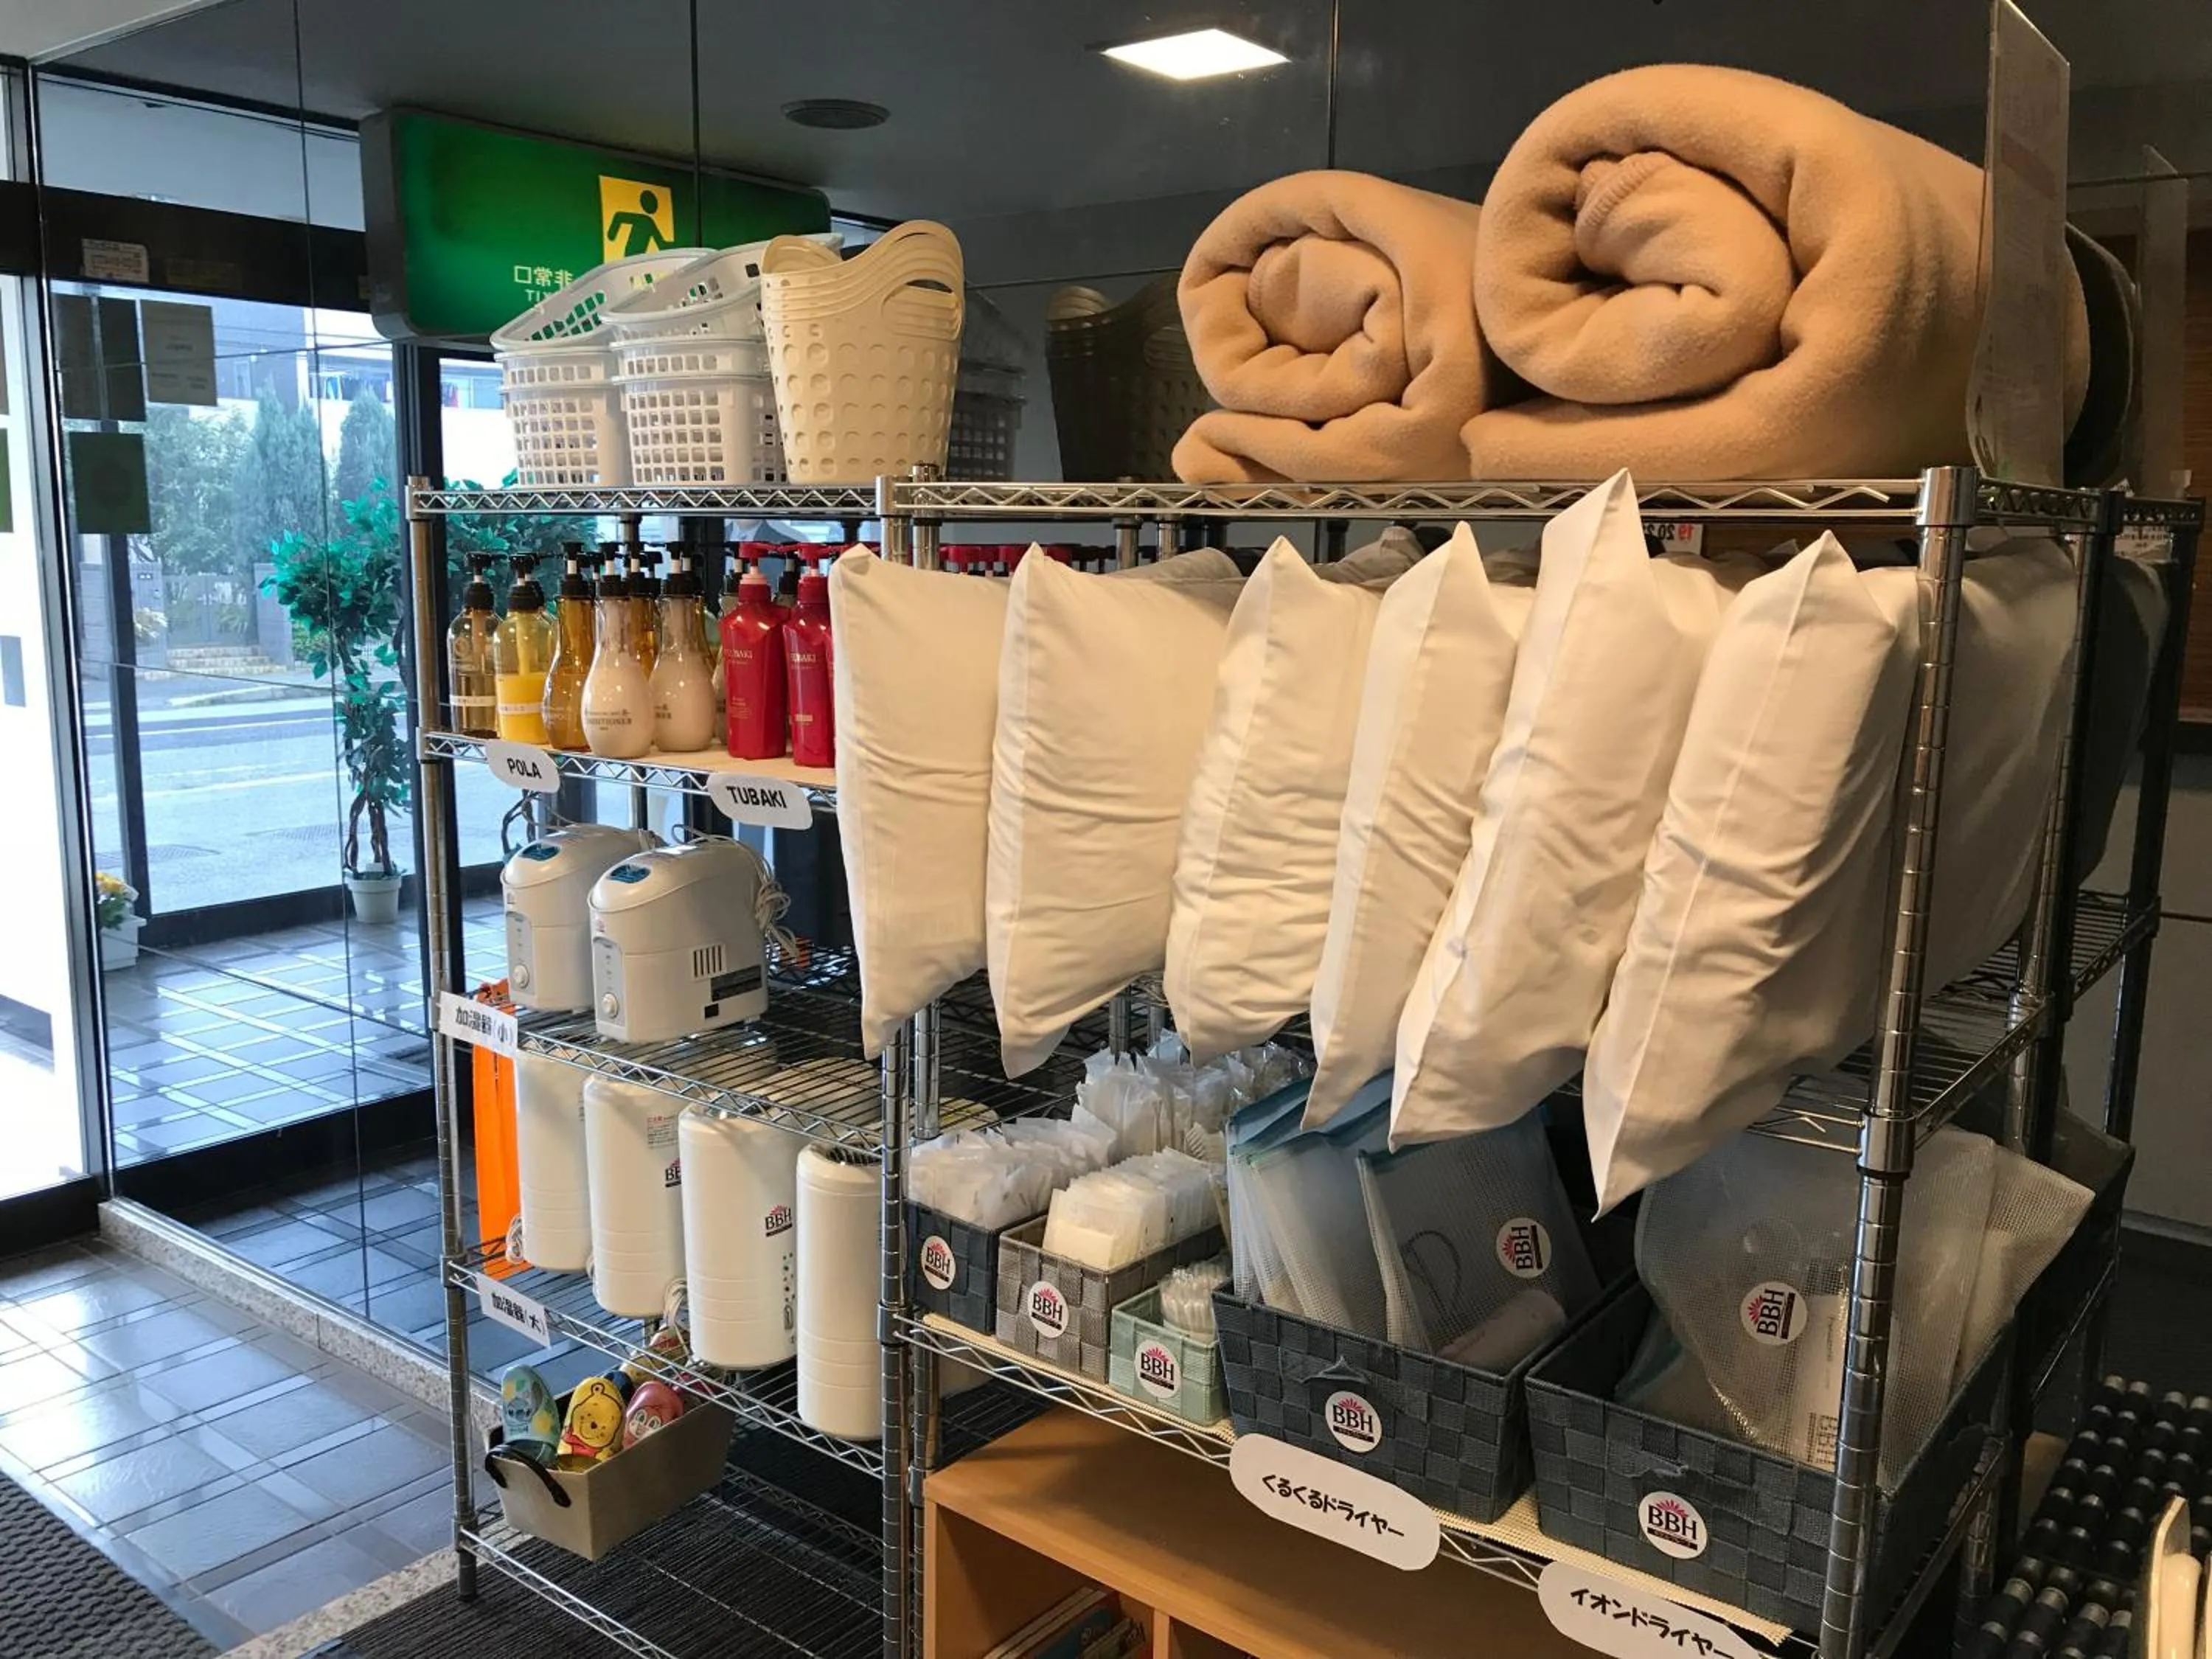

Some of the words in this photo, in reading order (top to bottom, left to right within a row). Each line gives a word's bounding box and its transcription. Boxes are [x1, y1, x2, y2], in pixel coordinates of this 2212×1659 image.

[507, 757, 542, 779] POLA
[726, 785, 787, 809] TUBAKI
[765, 1207, 792, 1231] BBH
[926, 1247, 950, 1275] BBH
[1511, 1226, 1533, 1269] BBH
[1033, 1293, 1062, 1321] BBH
[1757, 1289, 1784, 1336] BBH
[1141, 1352, 1175, 1381] BBH
[1333, 1404, 1373, 1433] BBH
[1262, 1474, 1405, 1537] くるくるドライヤー
[1649, 1504, 1697, 1540] BBH
[1571, 1587, 1734, 1659] イオンドライヤー
